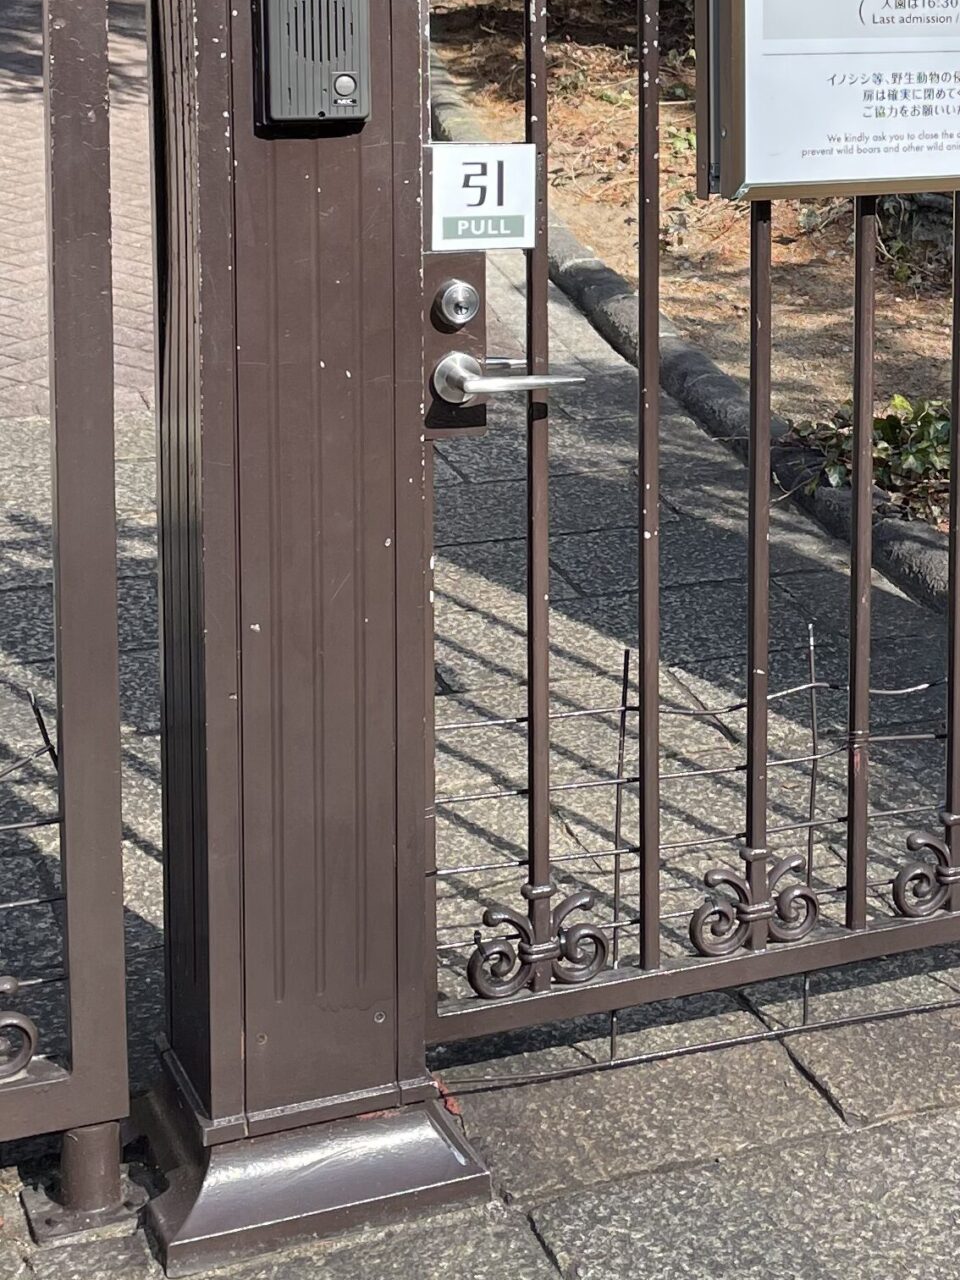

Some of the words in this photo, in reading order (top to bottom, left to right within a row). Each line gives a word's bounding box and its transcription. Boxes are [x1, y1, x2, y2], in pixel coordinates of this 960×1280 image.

[872, 13, 896, 24] Last
[899, 13, 952, 24] admission
[827, 133, 841, 144] We
[844, 132, 870, 144] kindly
[872, 131, 887, 142] ask
[889, 133, 905, 144] you
[907, 131, 916, 140] to
[918, 130, 939, 140] close
[941, 130, 955, 139] the
[801, 147, 834, 158] prevent
[836, 145, 854, 155] wild
[856, 145, 881, 155] boars
[882, 143, 900, 154] and
[902, 142, 925, 153] other
[926, 141, 944, 151] wild
[461, 160, 504, 207] 引
[457, 219, 511, 235] PULL
